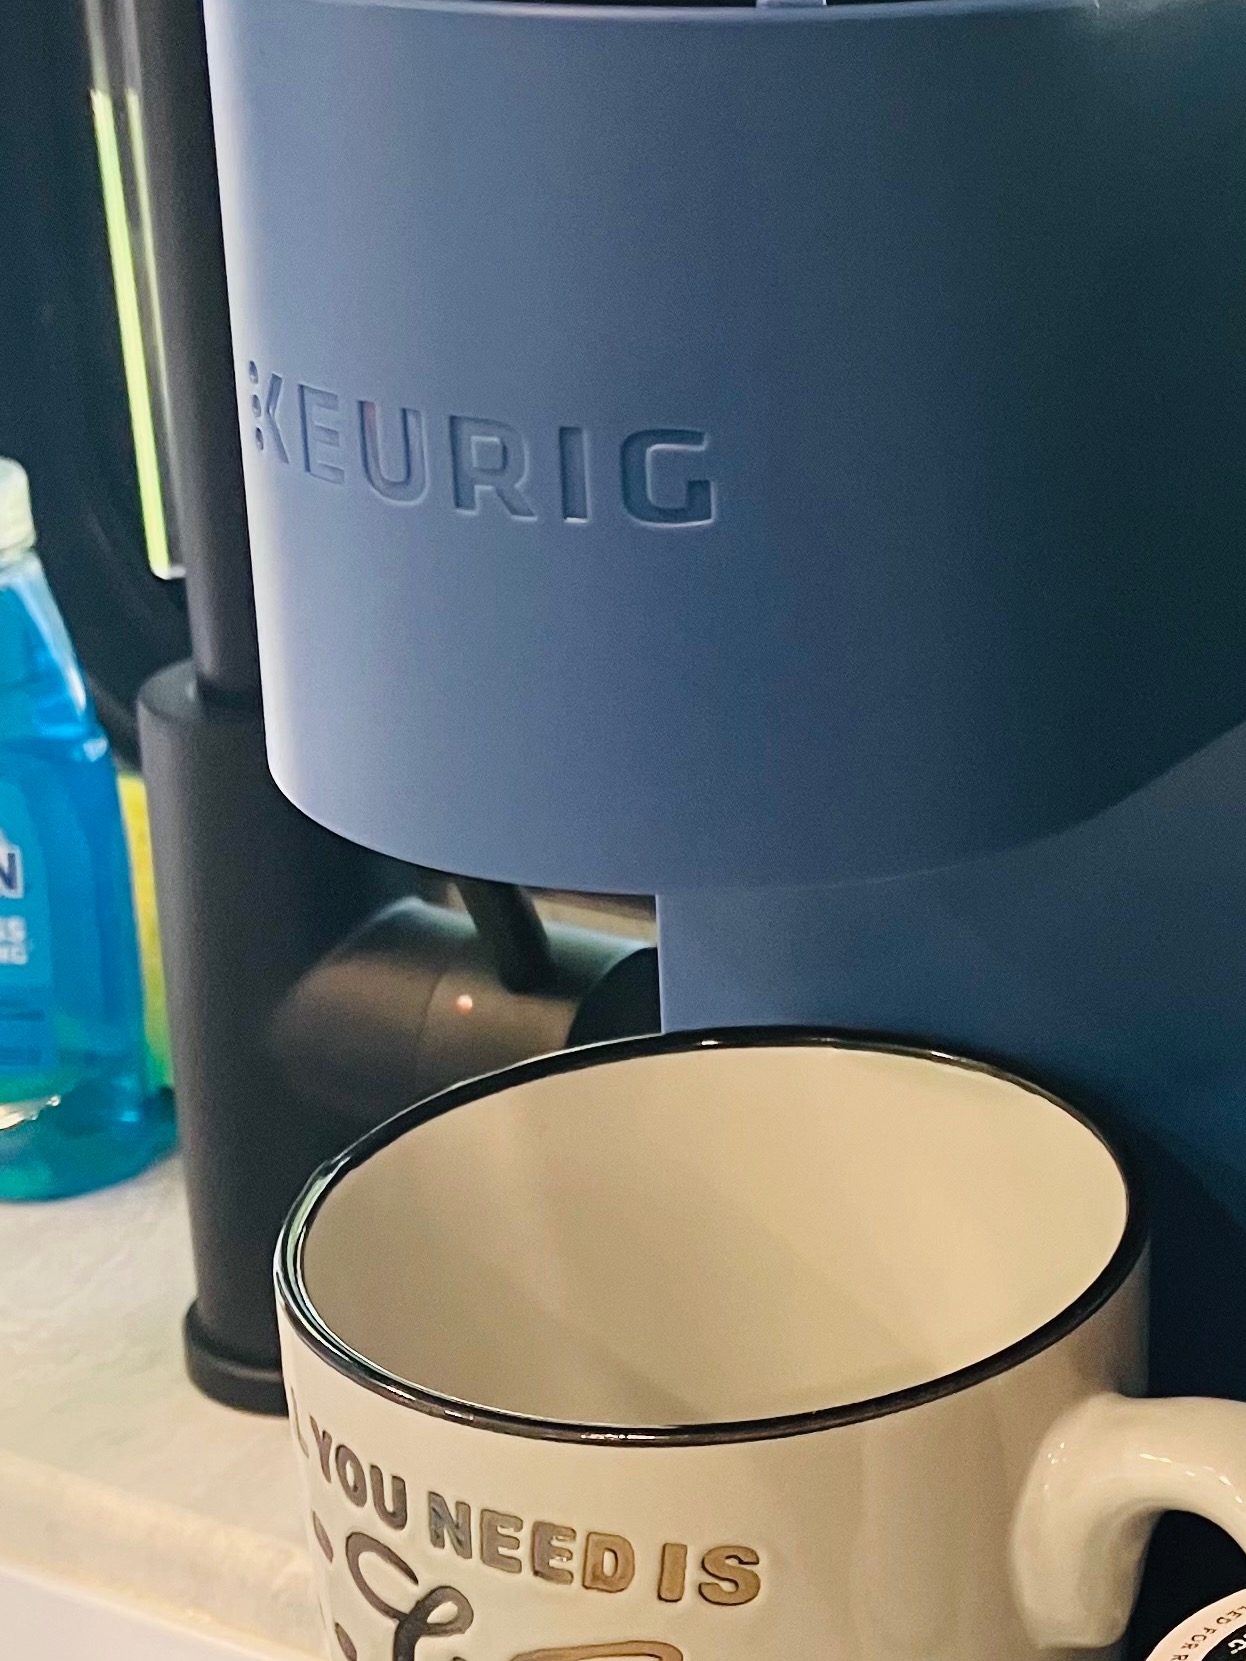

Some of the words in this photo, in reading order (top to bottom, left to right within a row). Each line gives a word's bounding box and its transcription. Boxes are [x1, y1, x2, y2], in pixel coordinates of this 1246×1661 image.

[248, 360, 716, 529] KEURIG
[309, 1414, 408, 1531] YOU
[427, 1490, 636, 1593] NEED
[657, 1541, 762, 1607] IS
[1181, 1627, 1217, 1650] FOR
